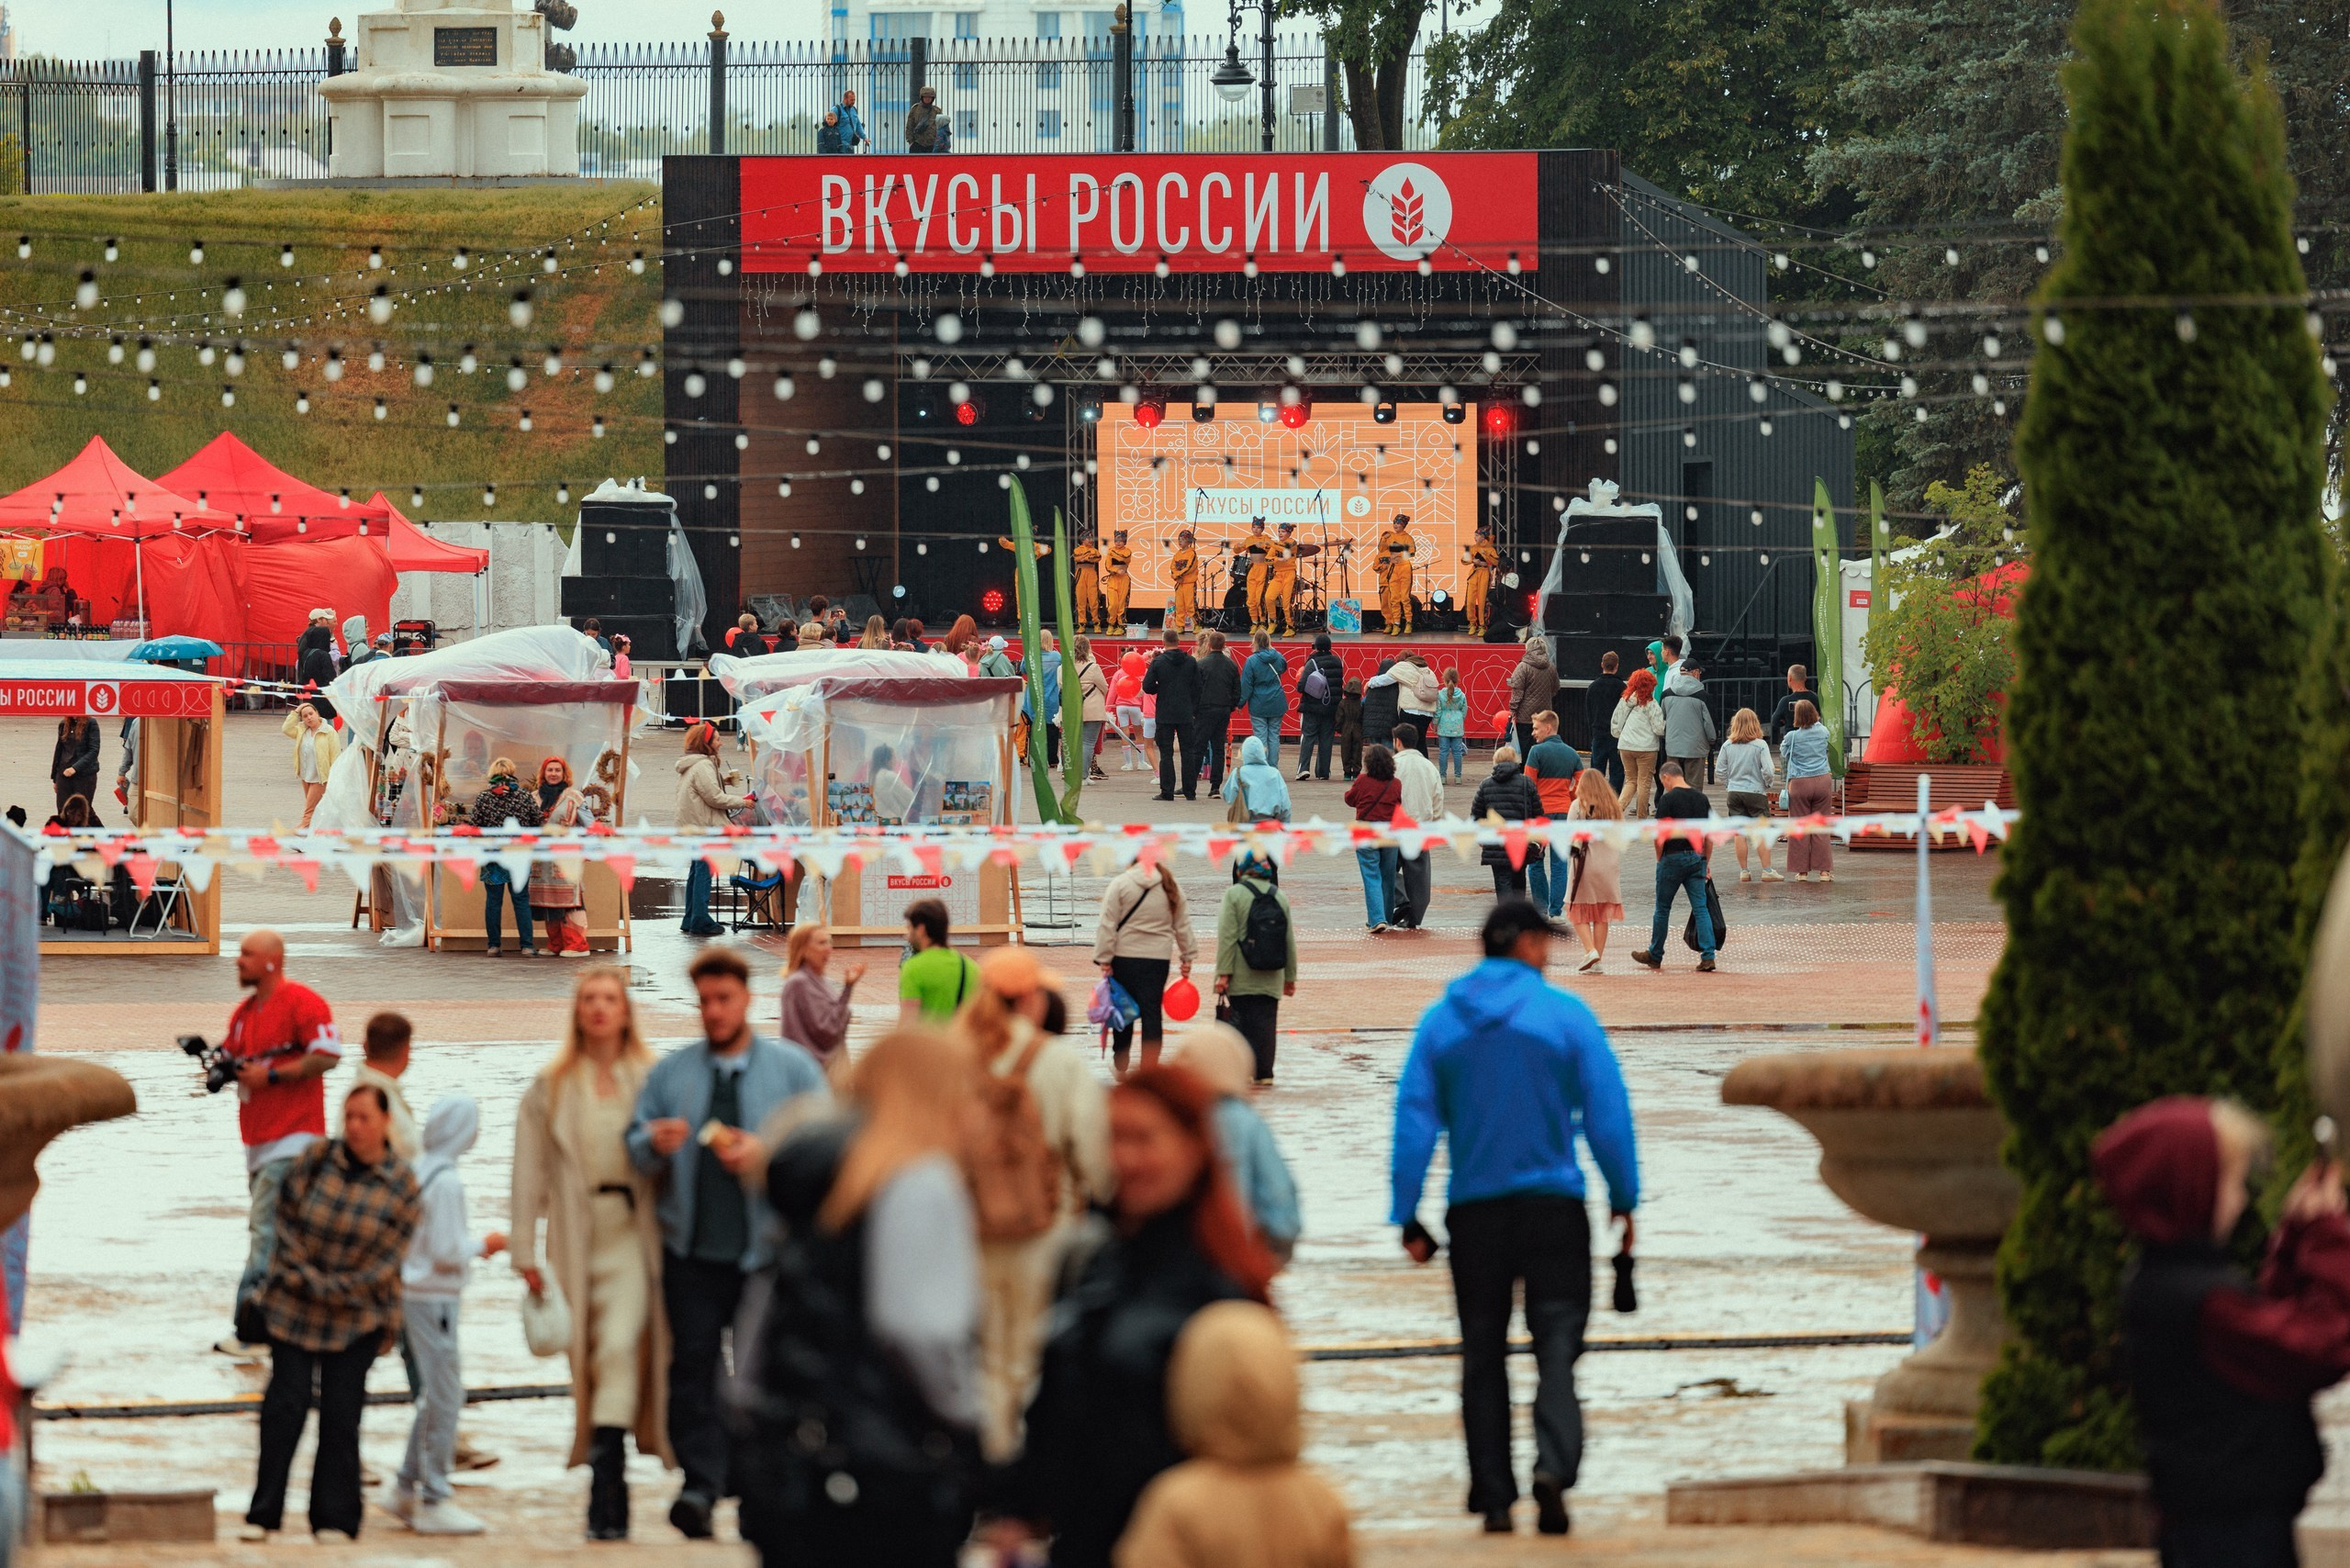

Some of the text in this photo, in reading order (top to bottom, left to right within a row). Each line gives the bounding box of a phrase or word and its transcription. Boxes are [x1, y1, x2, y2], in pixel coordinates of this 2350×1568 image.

[822, 172, 1329, 254] ВКУСЫ РОССИИ
[1195, 497, 1330, 515] ВКУСЫ РОССИИ
[17, 689, 77, 707] РОССИИ
[890, 878, 936, 886] ВКУСЫ РОССИИ
